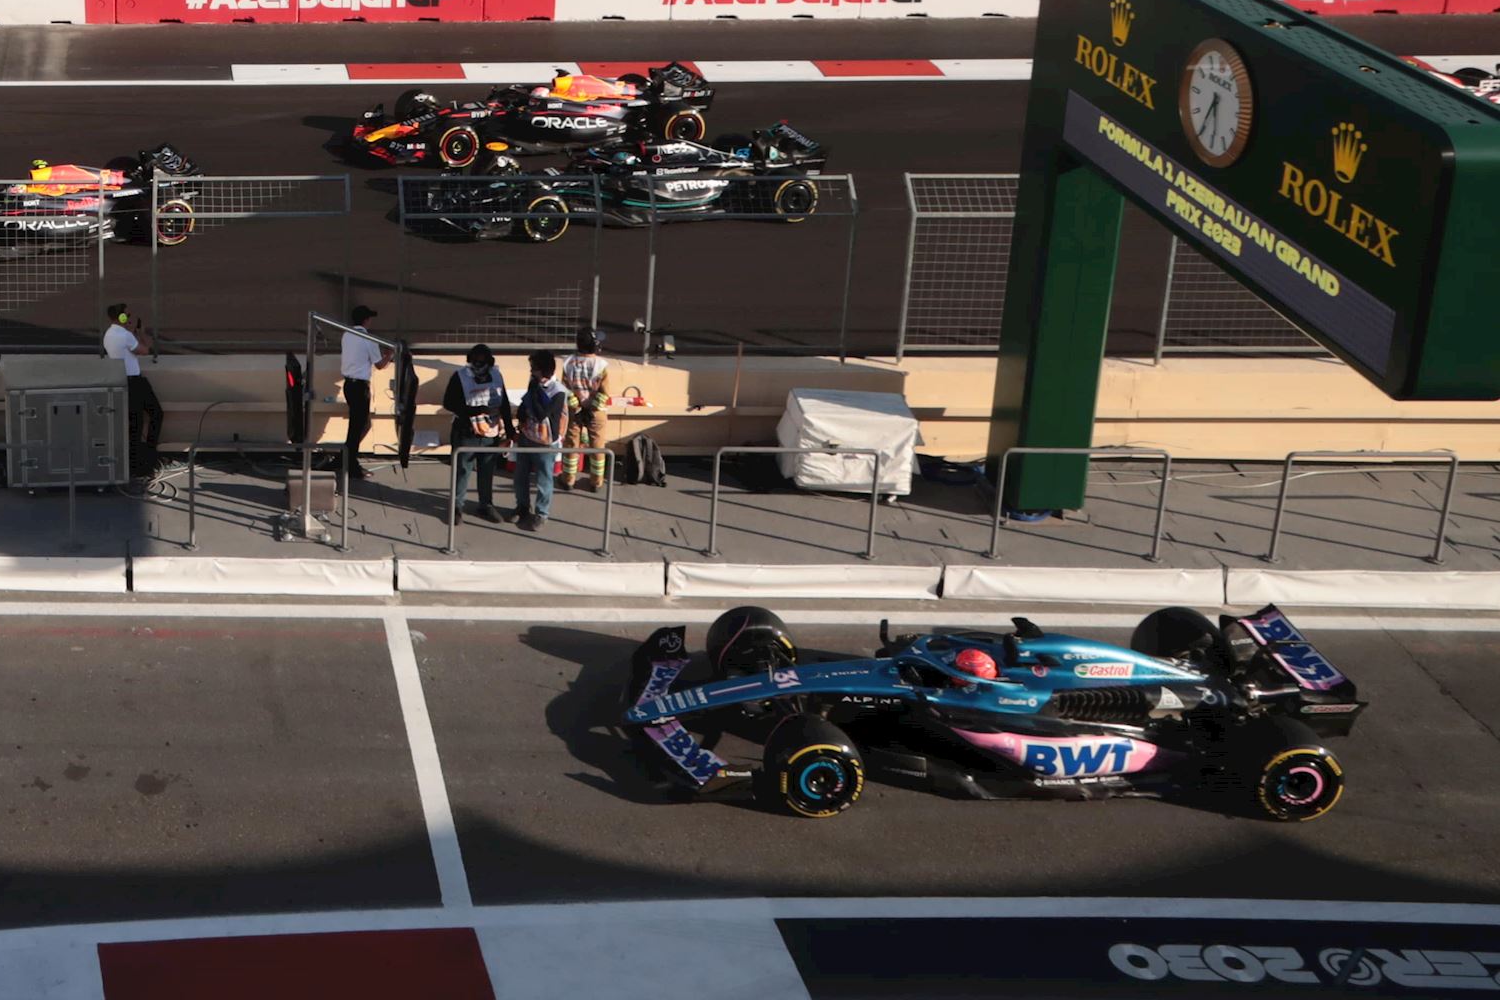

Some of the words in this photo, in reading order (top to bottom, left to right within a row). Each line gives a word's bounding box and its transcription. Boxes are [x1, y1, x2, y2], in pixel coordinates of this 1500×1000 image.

[1075, 34, 1157, 110] ROLEX
[531, 116, 609, 130] ORACLE
[1098, 115, 1164, 182] FORMULA
[1165, 161, 1175, 182] 1
[1174, 170, 1276, 253] AZERBAIJAN
[1275, 239, 1340, 298] GRAND
[1165, 188, 1201, 230] PRIX
[1201, 215, 1243, 257] 2023
[1278, 160, 1400, 267] ROLEX
[773, 669, 802, 689] 31
[1089, 664, 1131, 677] Castrol
[1025, 738, 1134, 777] BWT
